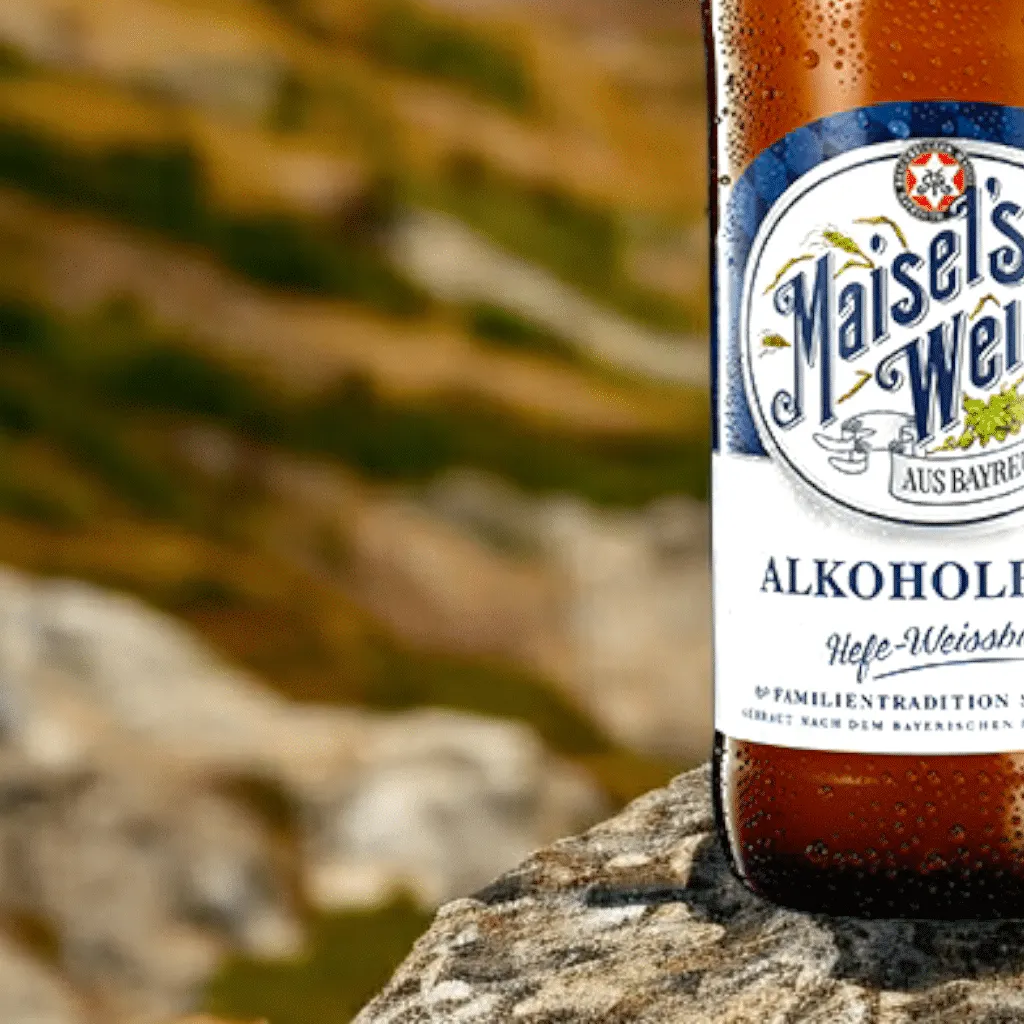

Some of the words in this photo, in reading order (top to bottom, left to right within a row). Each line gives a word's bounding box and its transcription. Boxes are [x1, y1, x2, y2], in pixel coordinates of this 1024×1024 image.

[902, 462, 946, 495] AUS
[773, 686, 1009, 711] FAMILIENTRADITION
[801, 714, 842, 729] NACH
[849, 718, 884, 731] DEM
[892, 719, 1014, 732] BAYERISCHEN
